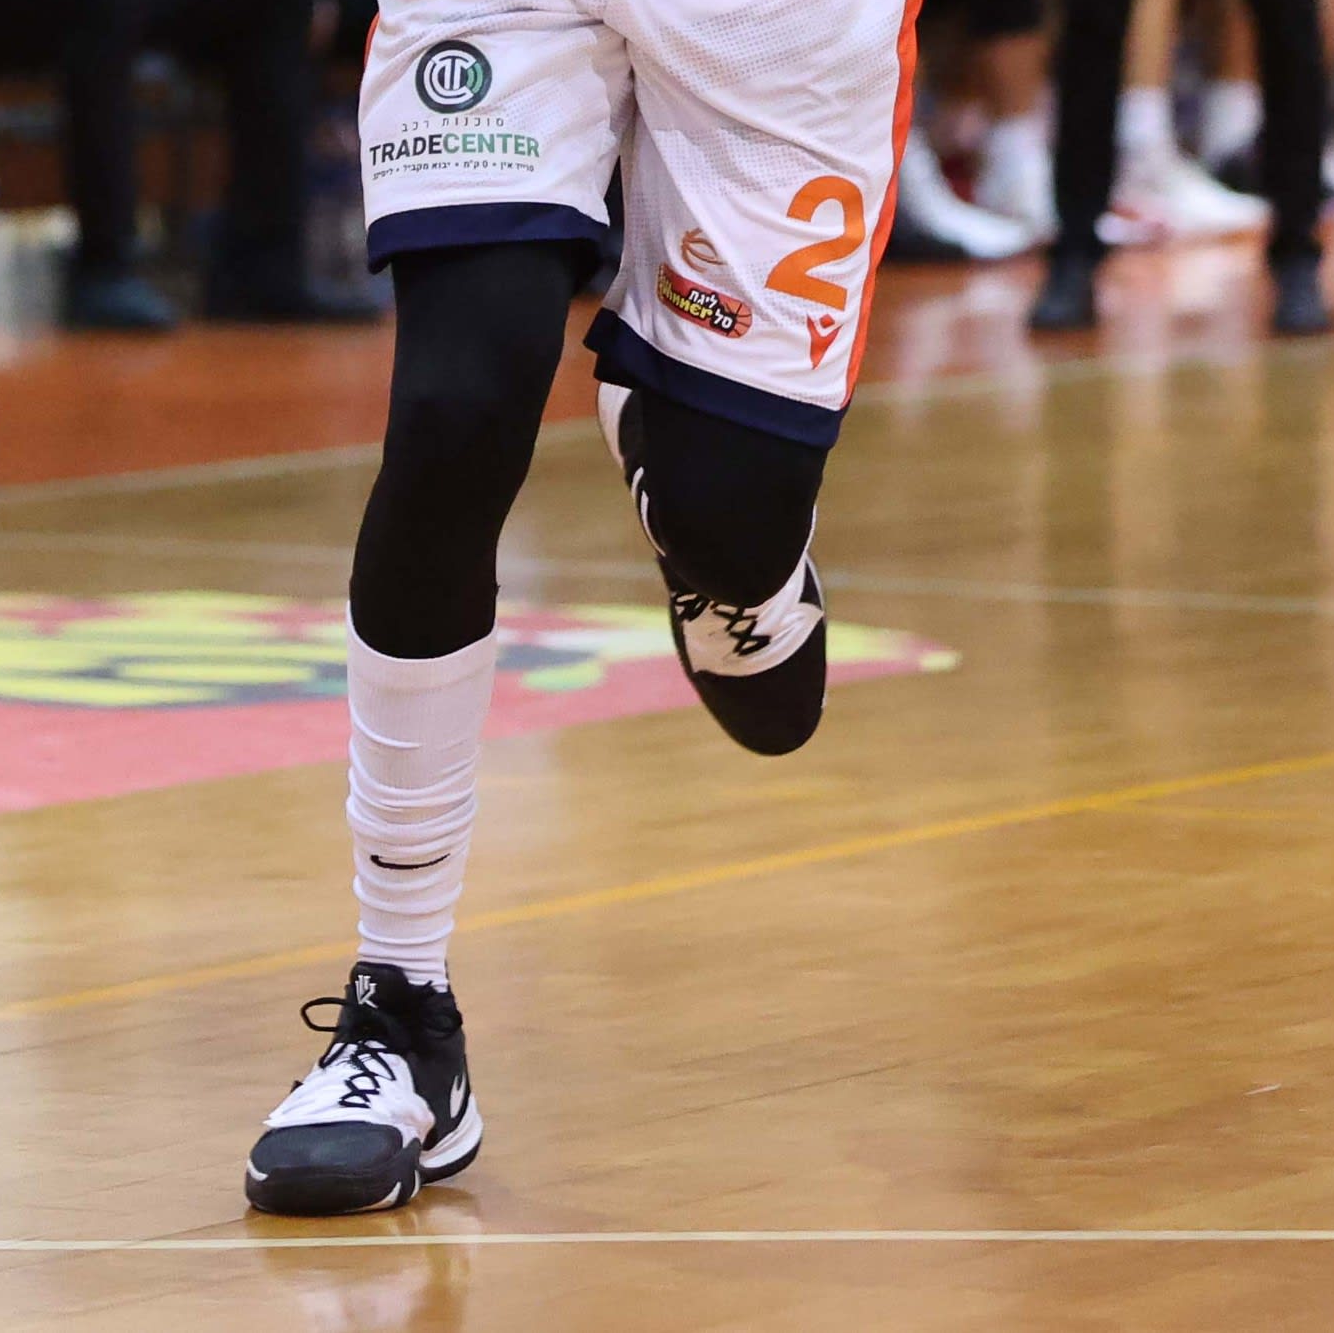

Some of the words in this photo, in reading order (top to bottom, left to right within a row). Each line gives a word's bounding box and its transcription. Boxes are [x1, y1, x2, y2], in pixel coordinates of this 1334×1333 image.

[401, 120, 430, 132] רכב
[442, 117, 505, 127] סוכנות
[765, 175, 867, 312] 2
[689, 290, 718, 309] ליגת
[713, 308, 733, 329] סל
